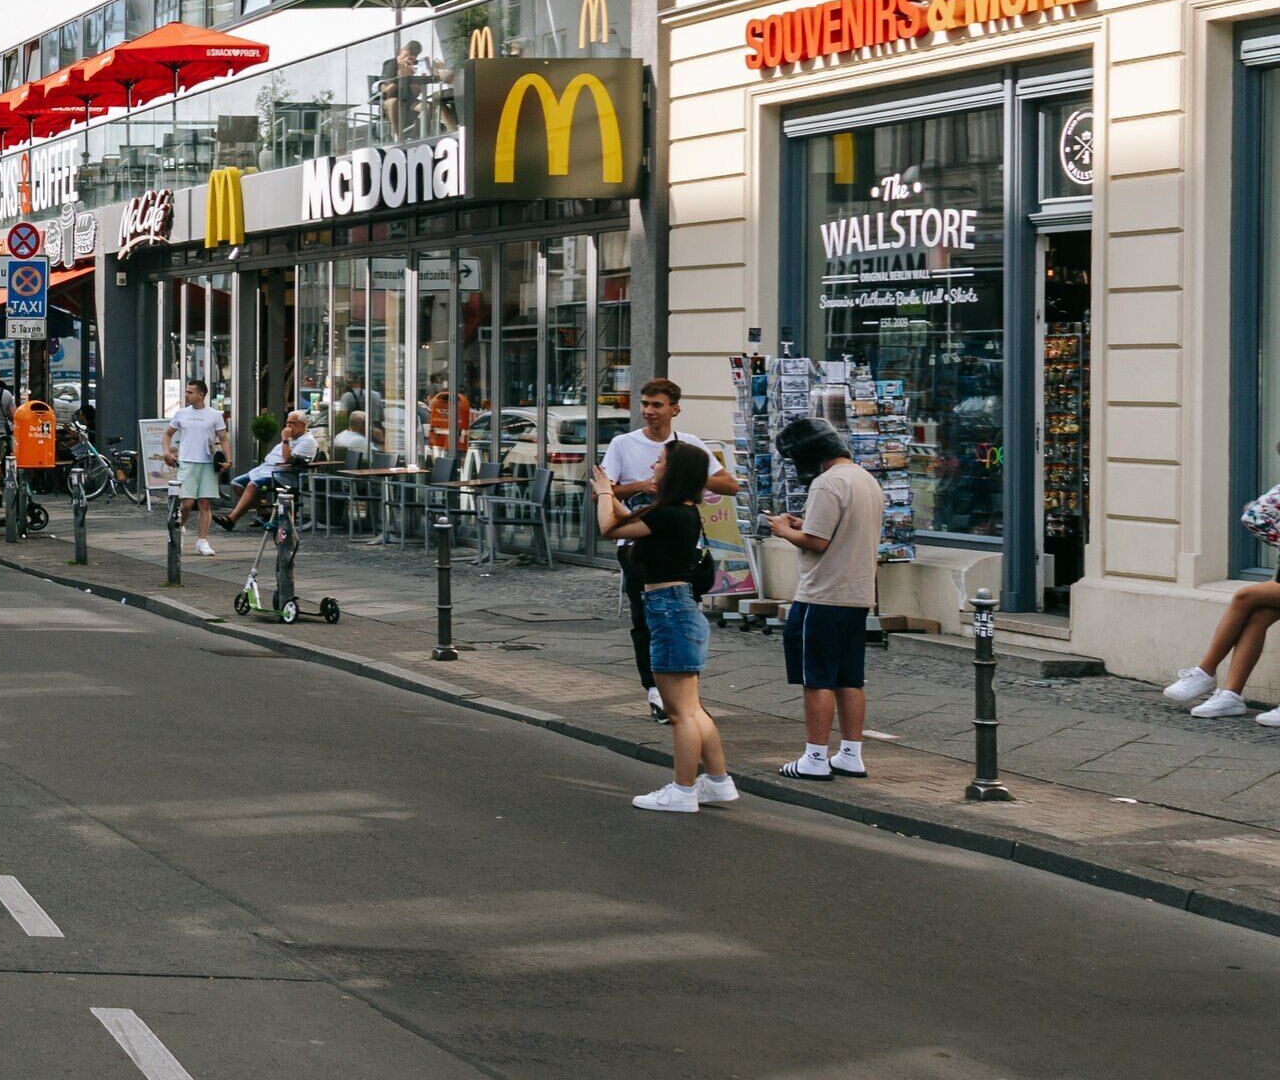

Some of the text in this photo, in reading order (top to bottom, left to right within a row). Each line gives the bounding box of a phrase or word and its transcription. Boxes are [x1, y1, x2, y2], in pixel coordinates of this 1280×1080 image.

[31, 139, 80, 212] COFFEE
[301, 126, 466, 220] McDonal
[1067, 161, 1094, 180] WALLST
[881, 173, 910, 202] The
[820, 207, 978, 259] WALLSTORE
[890, 270, 913, 281] BERLIN
[913, 269, 931, 280] WALL
[895, 289, 922, 306] Berlin
[922, 288, 944, 305] Wall
[948, 287, 979, 304] Shirts
[11, 301, 42, 314] TAXI
[19, 324, 41, 334] Taxen
